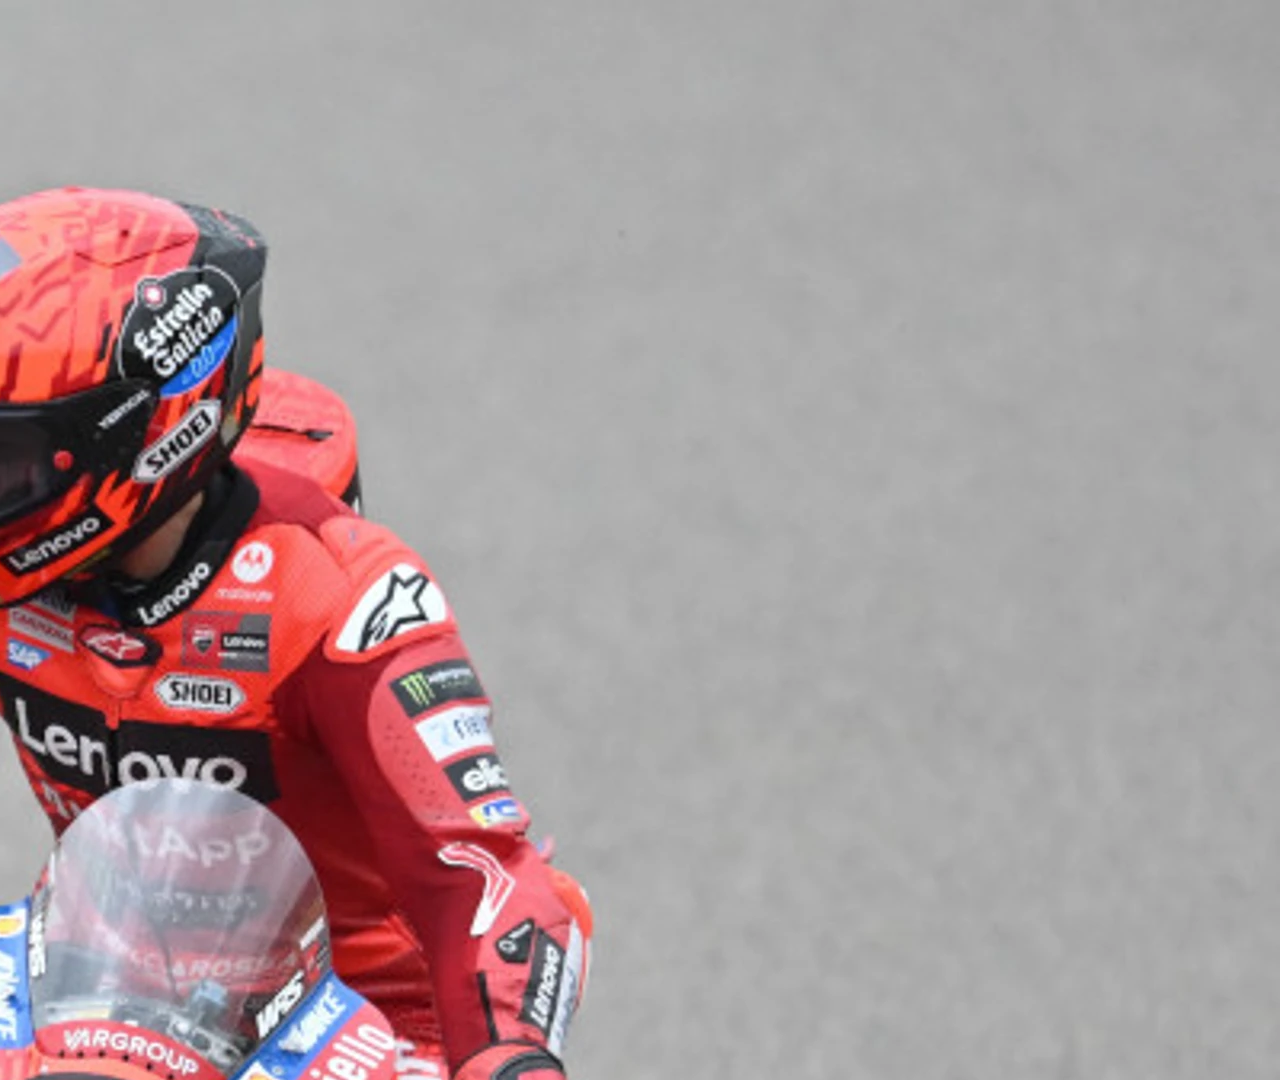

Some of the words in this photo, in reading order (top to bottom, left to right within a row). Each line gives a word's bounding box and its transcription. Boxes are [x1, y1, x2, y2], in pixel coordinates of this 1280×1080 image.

[133, 283, 214, 361] Estrella
[152, 306, 224, 378] Galicia
[145, 407, 214, 475] SHOEI
[7, 516, 102, 571] Lenovo
[137, 562, 210, 626] Lenovo
[170, 680, 232, 706] SHOEI
[15, 697, 247, 791] Lenovo
